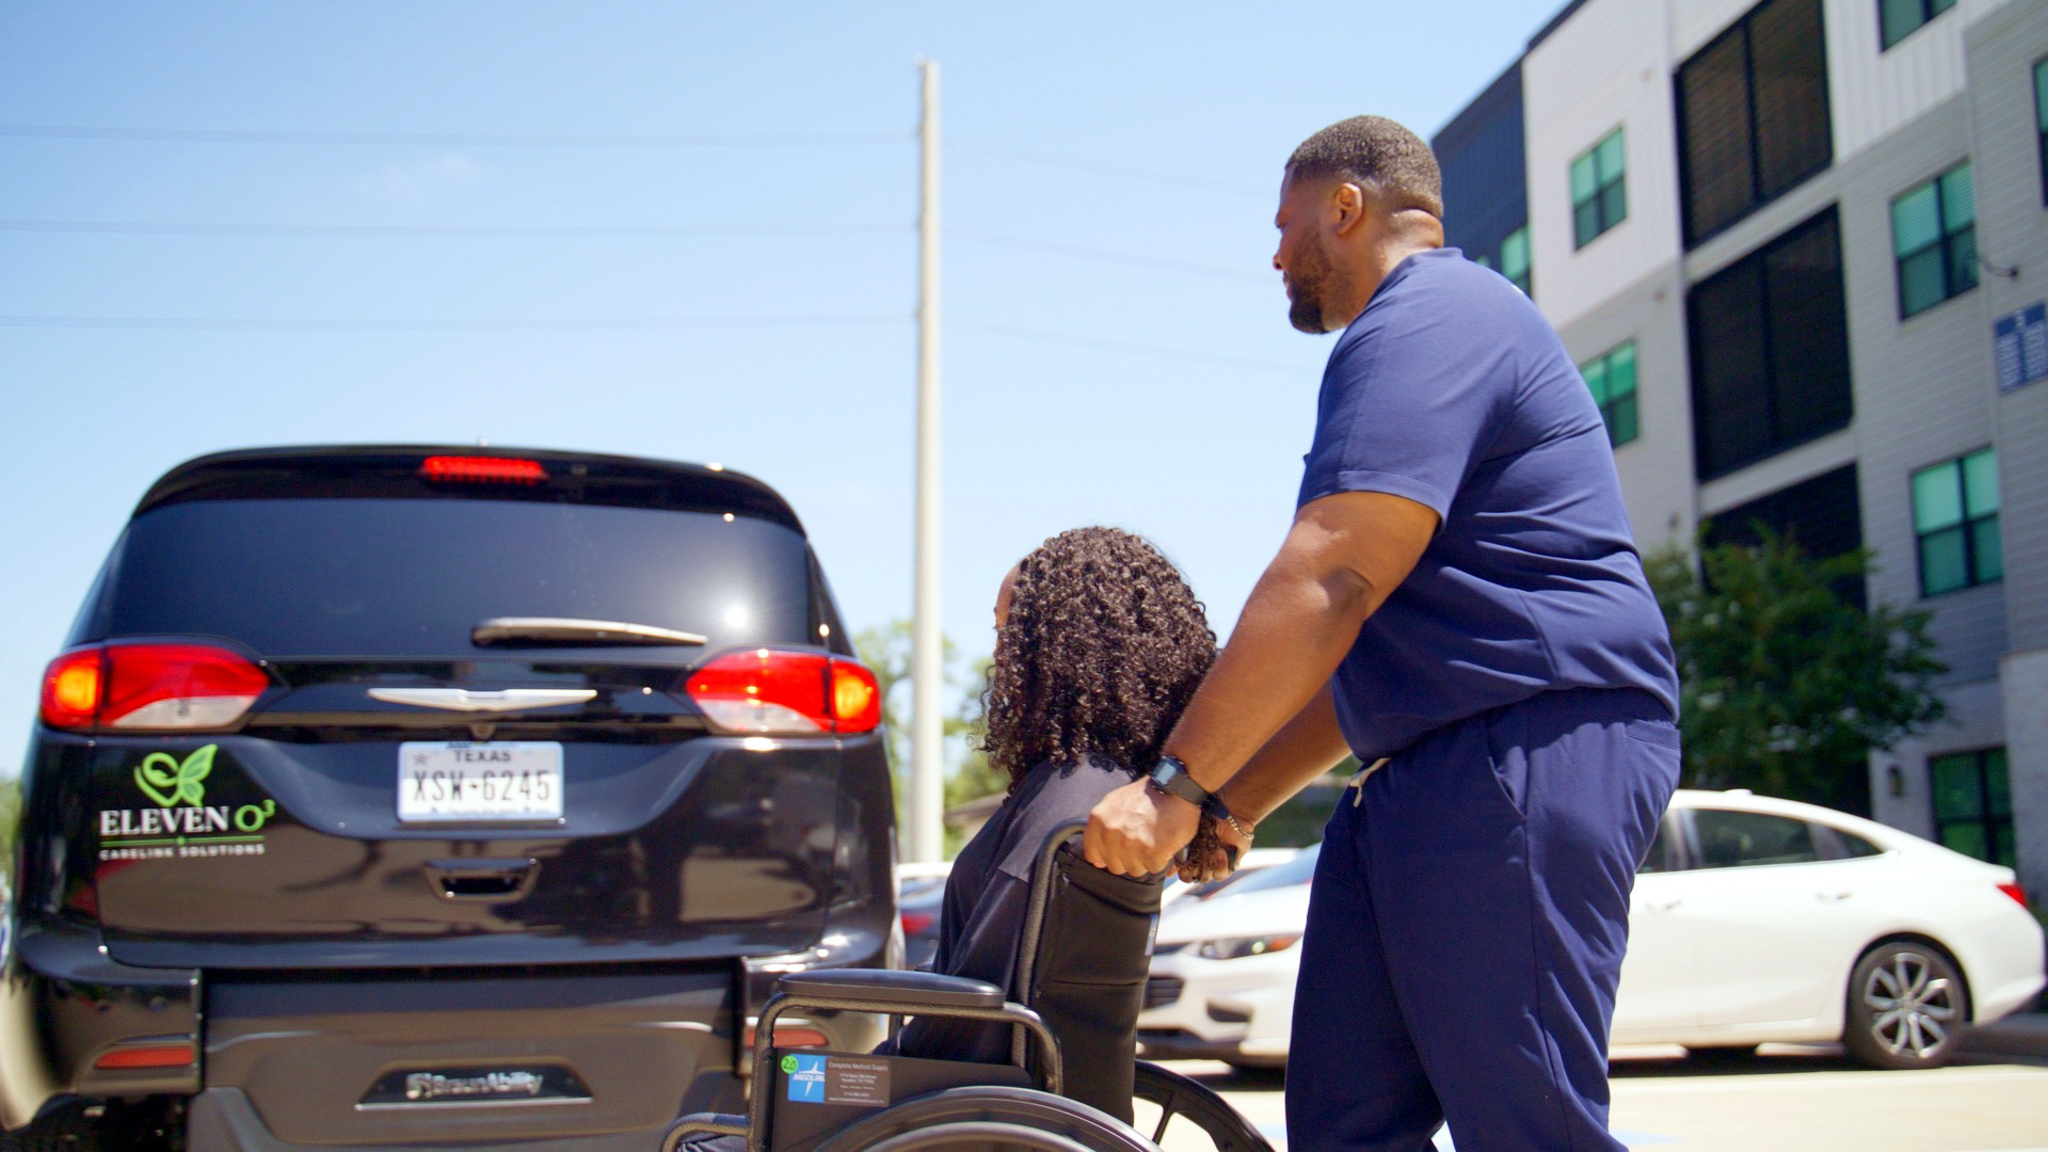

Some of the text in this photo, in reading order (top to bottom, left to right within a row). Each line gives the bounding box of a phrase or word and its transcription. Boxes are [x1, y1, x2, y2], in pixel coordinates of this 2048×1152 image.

[455, 750, 512, 762] TEXAS
[100, 806, 230, 836] ELEVEN
[99, 843, 265, 861] CARELINK SOLUTIONS
[793, 1073, 825, 1082] MEDLIN
